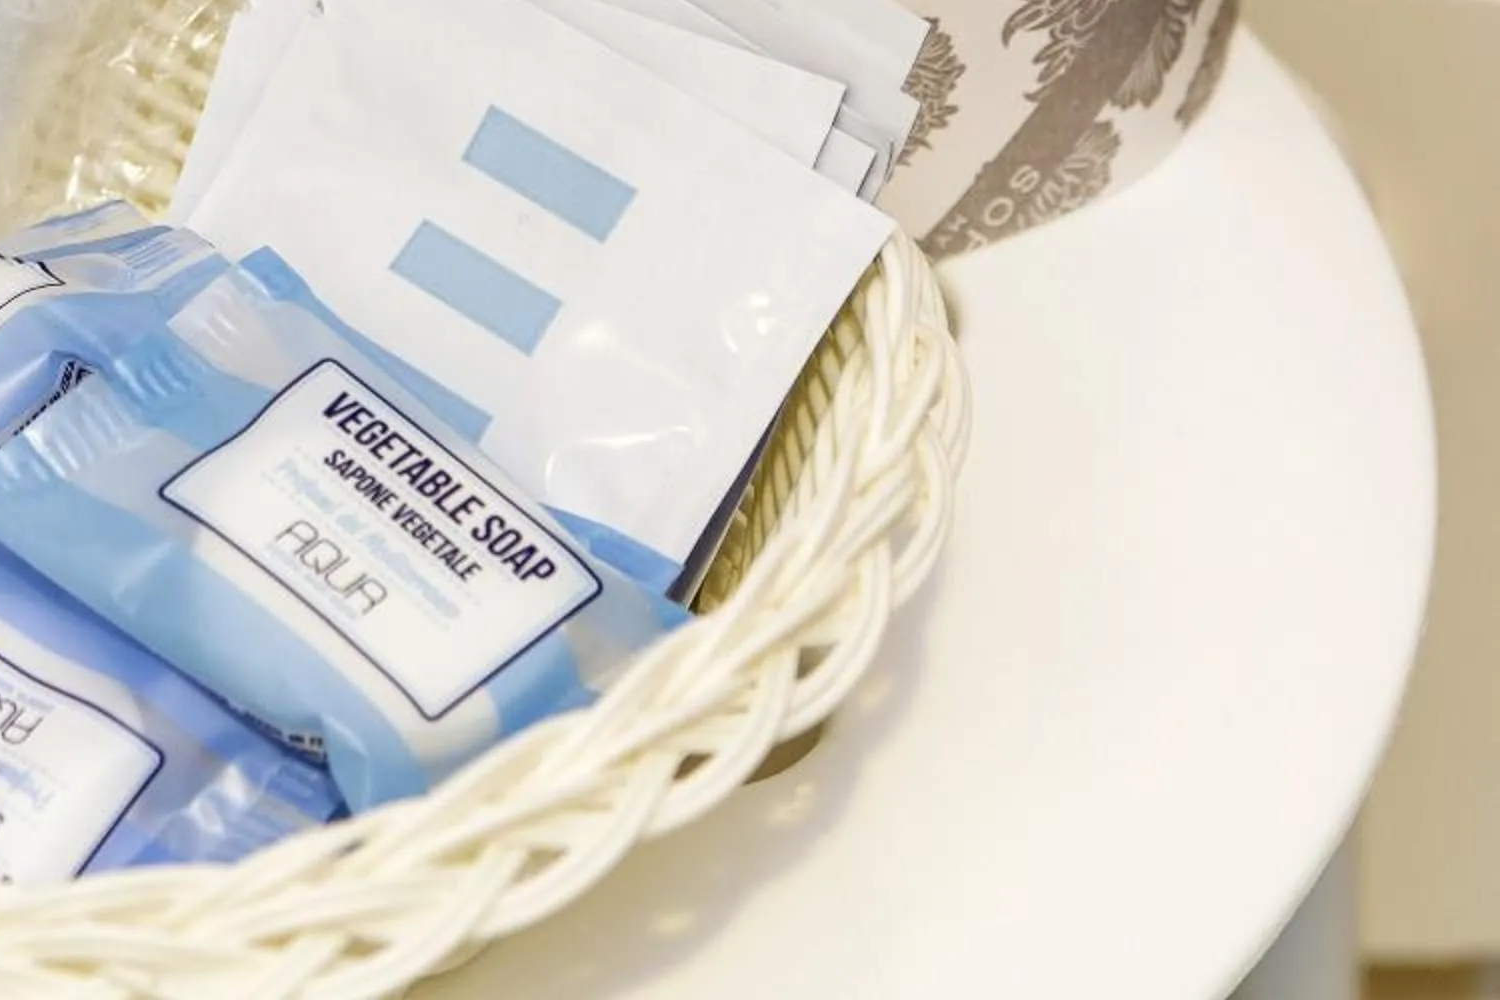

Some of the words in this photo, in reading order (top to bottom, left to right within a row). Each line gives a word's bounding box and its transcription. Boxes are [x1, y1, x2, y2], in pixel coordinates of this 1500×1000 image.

[321, 389, 480, 524] VEGETABLE
[470, 512, 557, 589] SOAP
[323, 447, 395, 511] SAPONE
[393, 502, 482, 583] VEGETALE
[273, 516, 391, 616] AQUA
